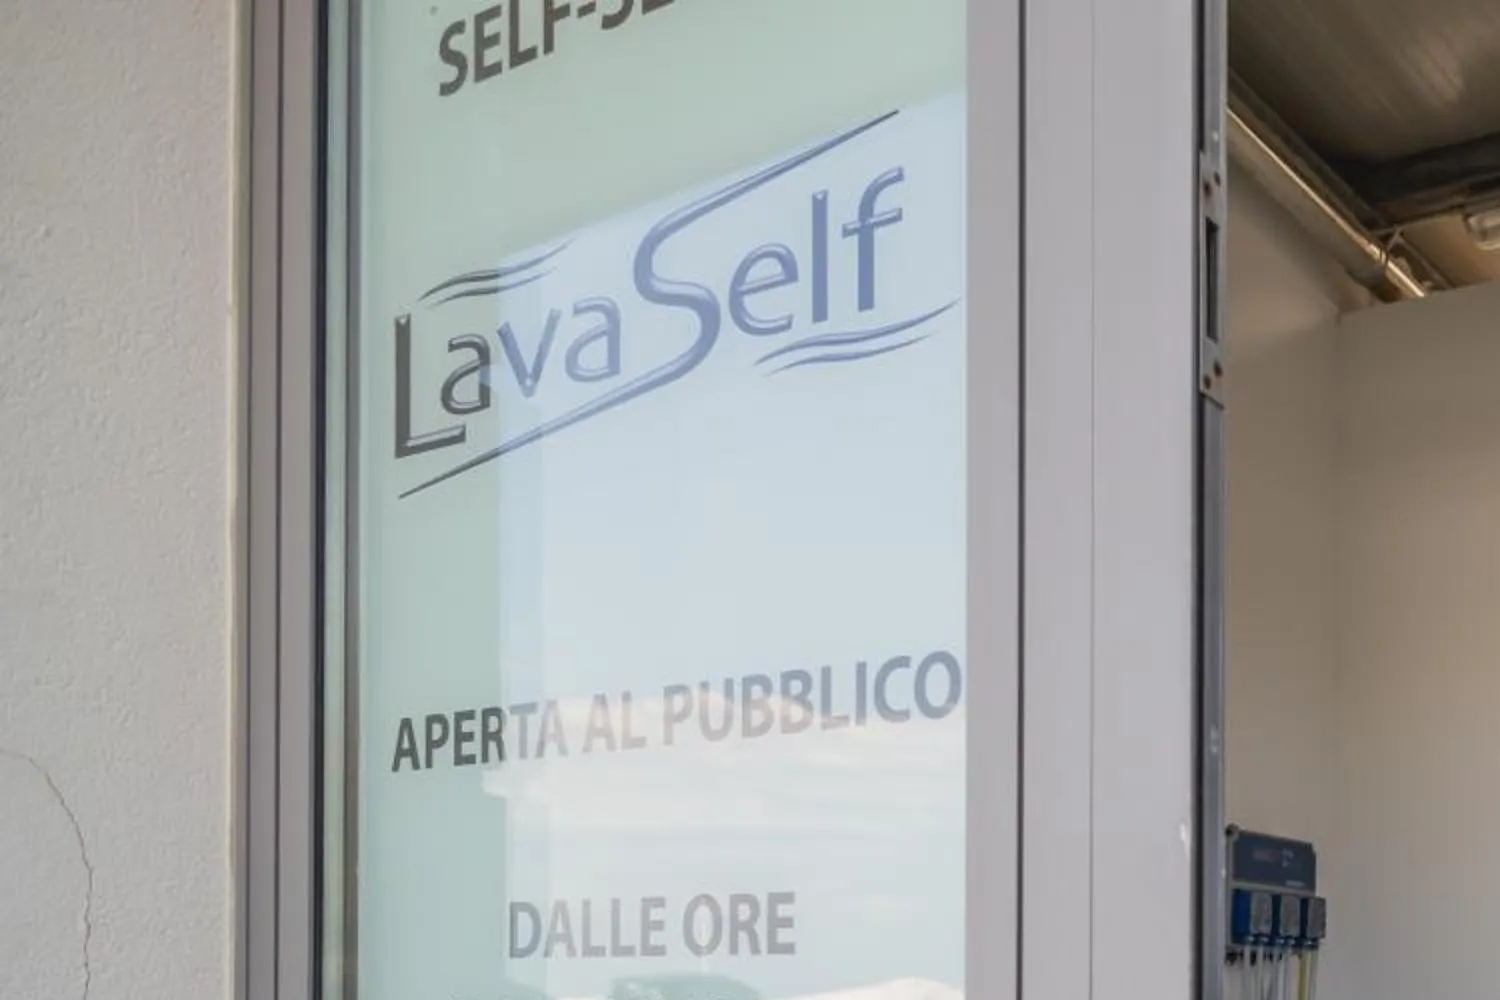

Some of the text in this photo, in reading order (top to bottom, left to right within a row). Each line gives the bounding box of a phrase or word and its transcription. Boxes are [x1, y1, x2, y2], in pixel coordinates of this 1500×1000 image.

[439, 0, 676, 97] SELF-
[391, 650, 963, 772] APERTA AL PUBBLICO
[508, 891, 798, 960] DALLE ORE
